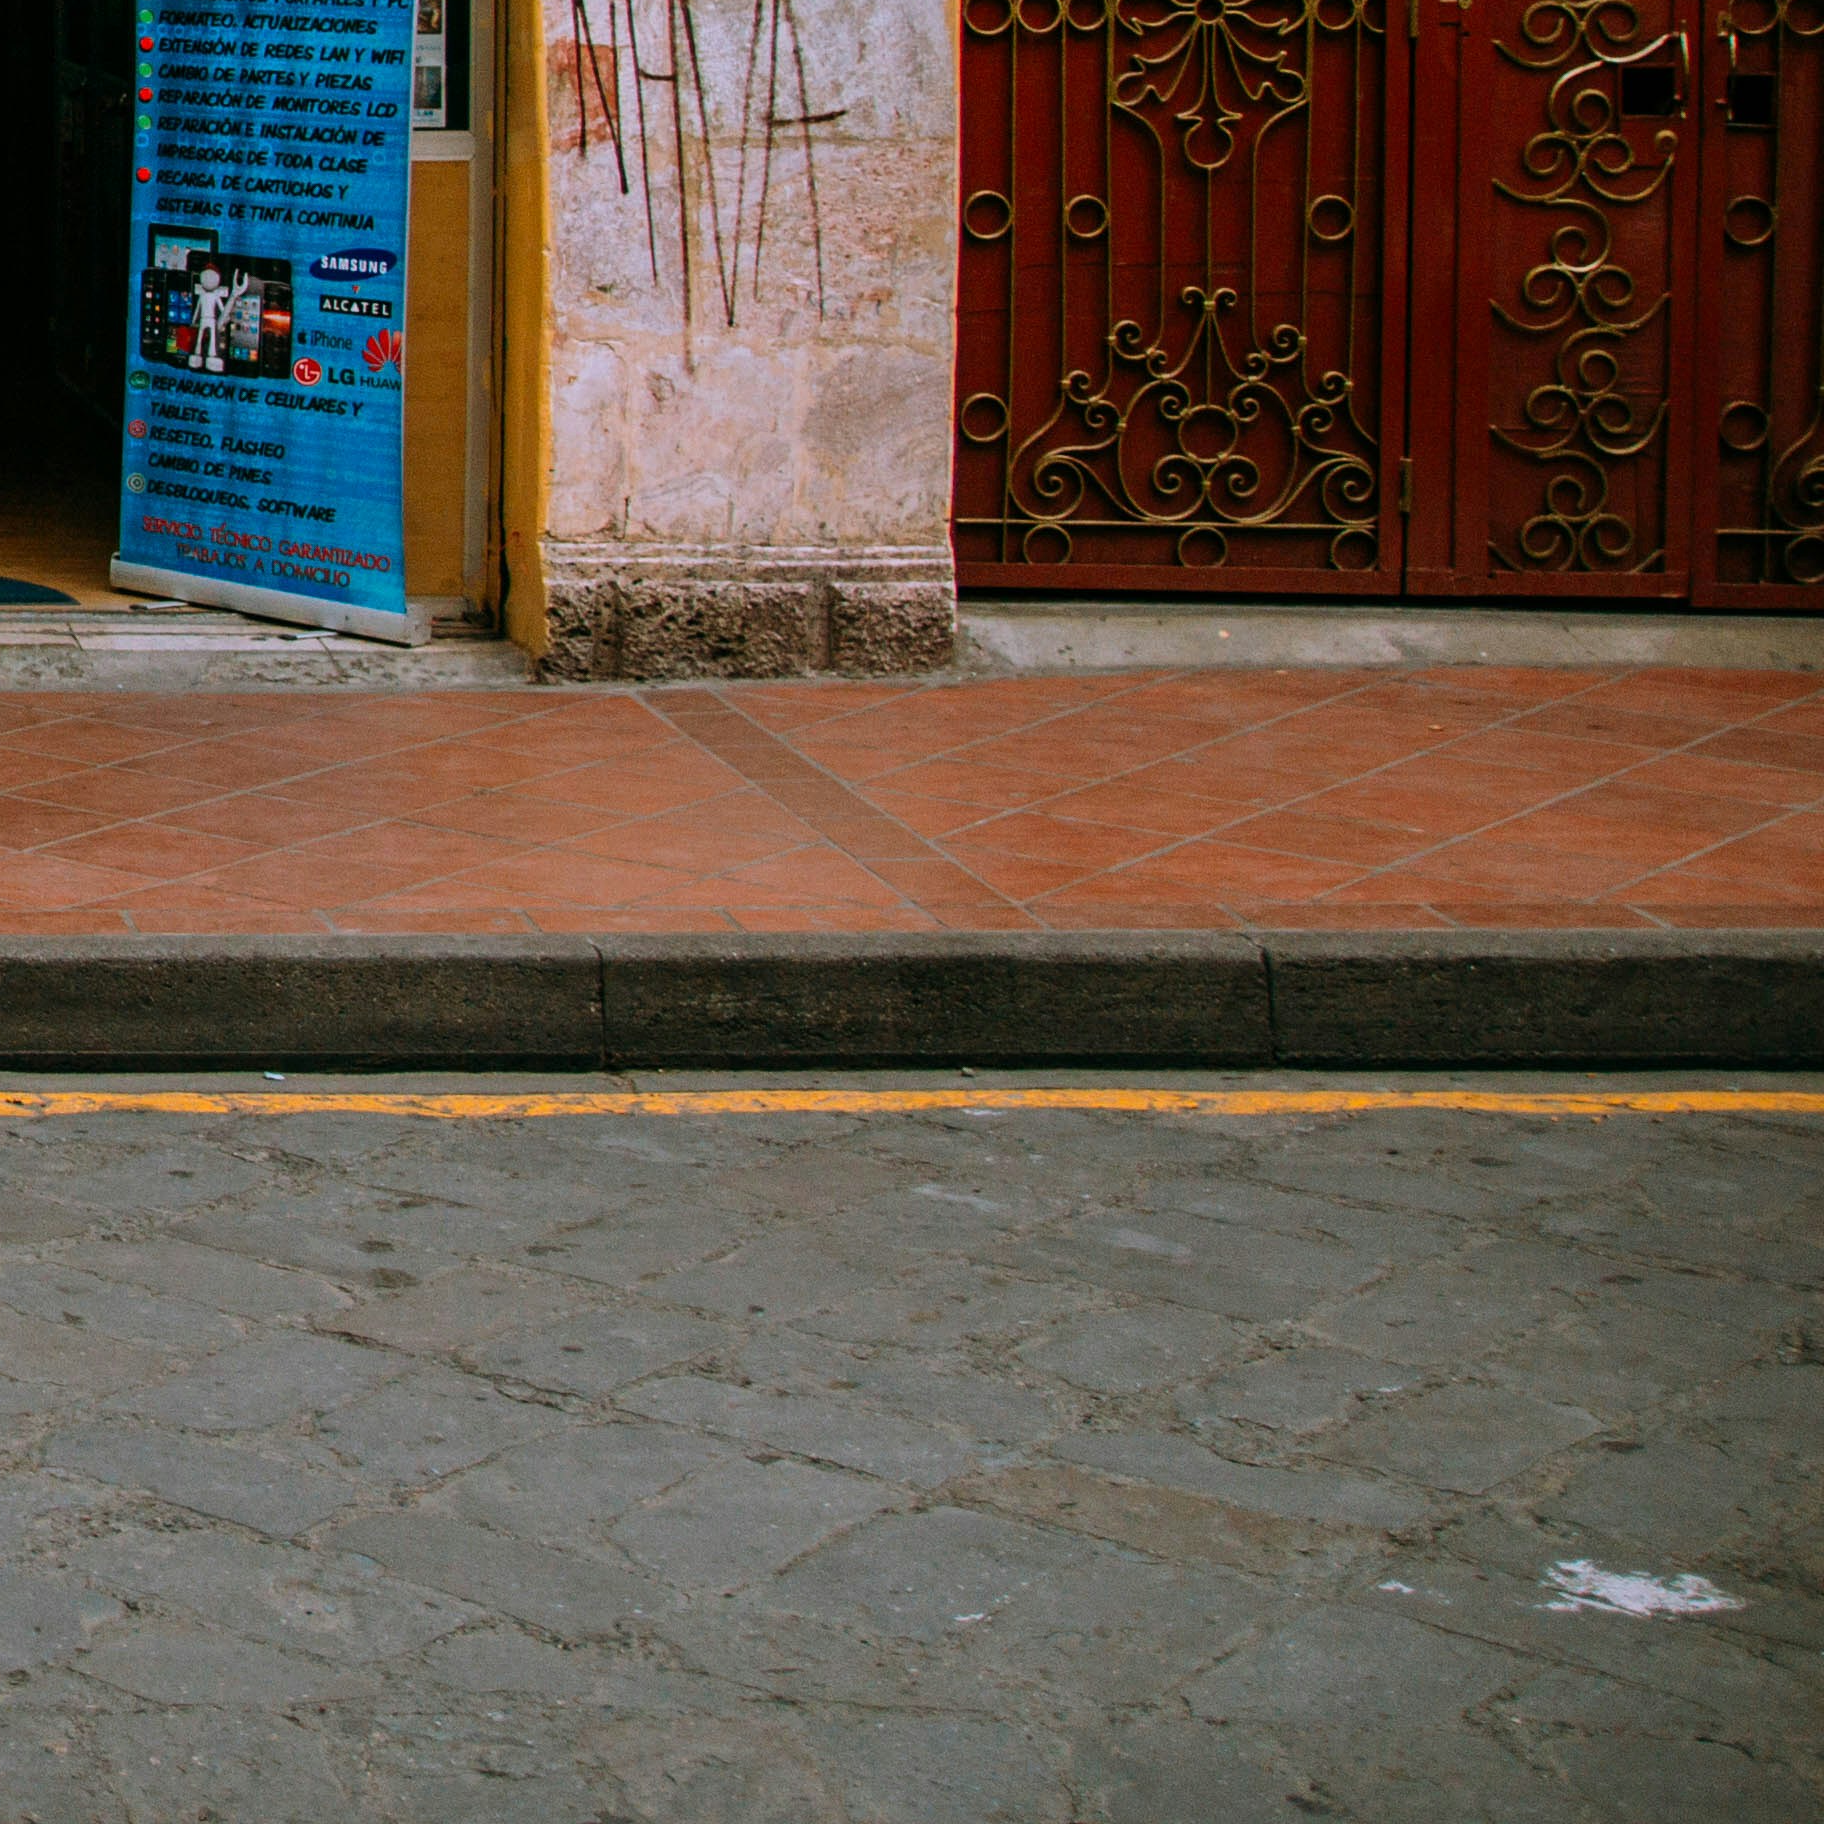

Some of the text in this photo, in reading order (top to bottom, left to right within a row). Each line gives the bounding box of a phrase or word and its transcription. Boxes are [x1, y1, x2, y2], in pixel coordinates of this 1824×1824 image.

[244, 14, 378, 35] ACTUALIZACIONES
[241, 43, 259, 58] DE
[264, 43, 315, 61] REDES
[319, 47, 350, 62] LAN
[355, 48, 366, 63] Y
[371, 50, 405, 65] WIFI
[215, 67, 236, 82] DE
[240, 69, 295, 86] PARTES
[299, 72, 310, 85] Y
[315, 72, 373, 92] PIEZAS
[245, 95, 267, 109] DE
[272, 97, 361, 116] MONITORES
[366, 102, 398, 118] LCD
[244, 121, 259, 136] E
[363, 130, 386, 147] DE
[247, 149, 268, 165] DE
[274, 152, 313, 169] TODA
[318, 155, 368, 173] CLASE
[156, 170, 349, 199] RECARGA DE CARTUCHOS Y
[228, 204, 247, 219] DE
[251, 206, 293, 223] TINTA
[297, 210, 374, 231] CONTINUA
[321, 256, 388, 275] SAMSUNG
[323, 298, 389, 316] ALCATEL
[310, 330, 352, 350] iPhone
[328, 367, 355, 385] LG
[238, 389, 259, 404] DE
[351, 402, 365, 417] Y
[220, 436, 285, 459] FLASHEO
[204, 462, 224, 477] DE
[228, 465, 272, 485] PINES
[257, 498, 336, 523] SOFTWARE
[254, 558, 265, 573] A
[278, 540, 391, 573] GARANTIZADO
